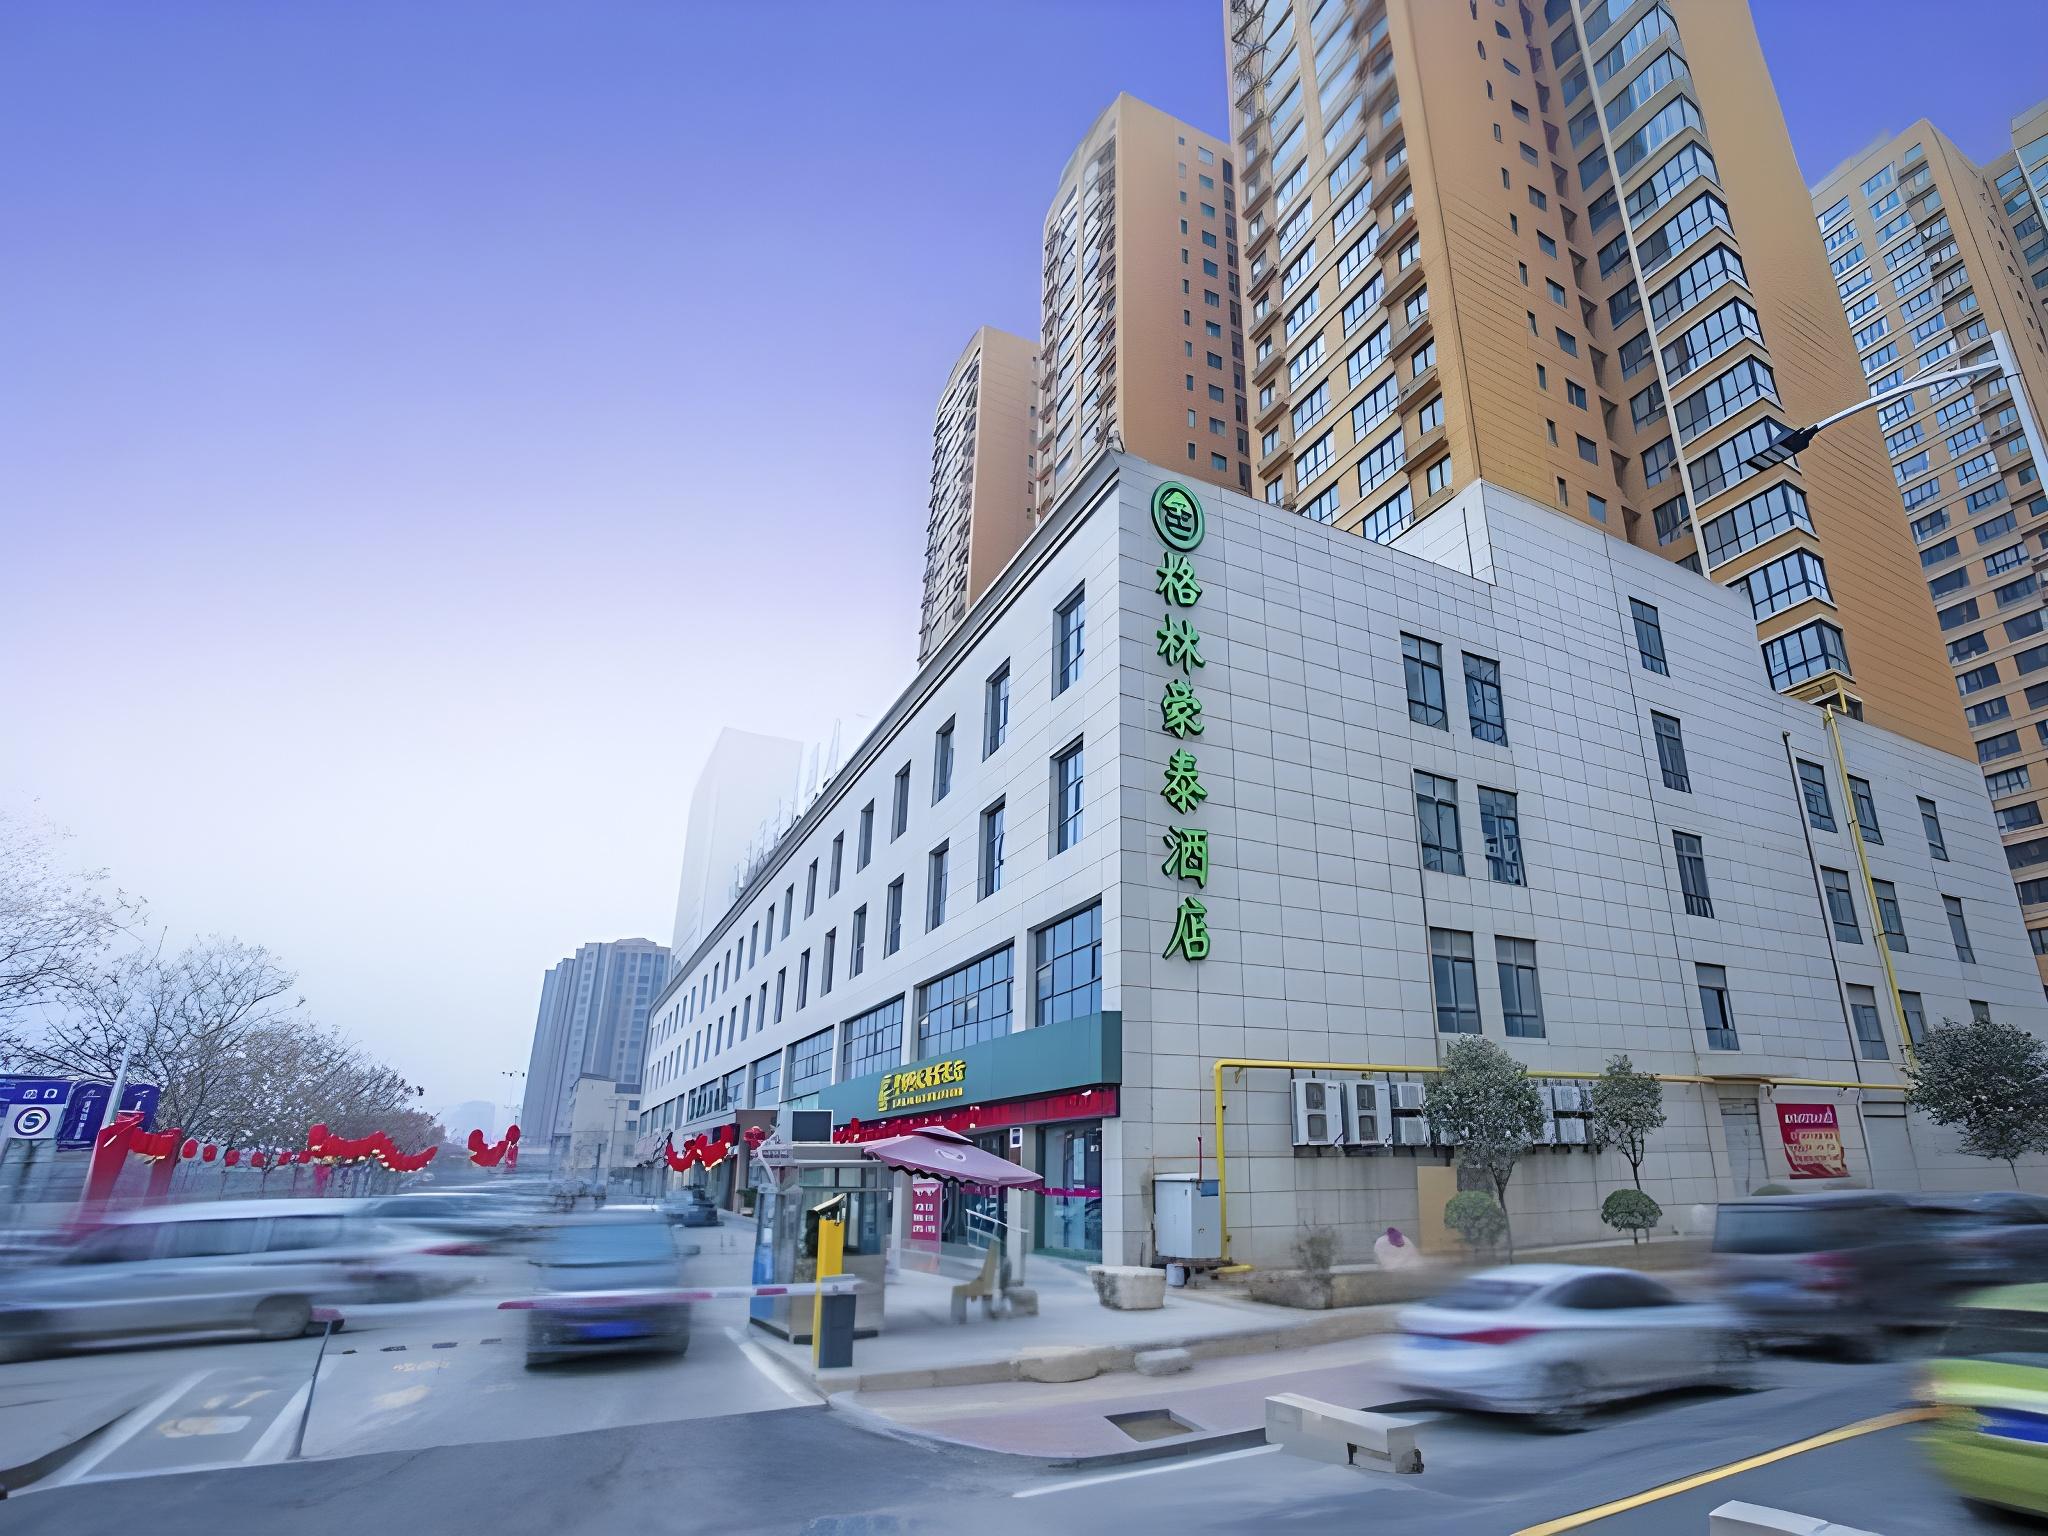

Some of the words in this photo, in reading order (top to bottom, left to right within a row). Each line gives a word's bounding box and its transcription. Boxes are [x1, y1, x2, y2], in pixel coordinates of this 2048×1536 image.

[1155, 551, 1210, 961] 格林豪泰酒店
